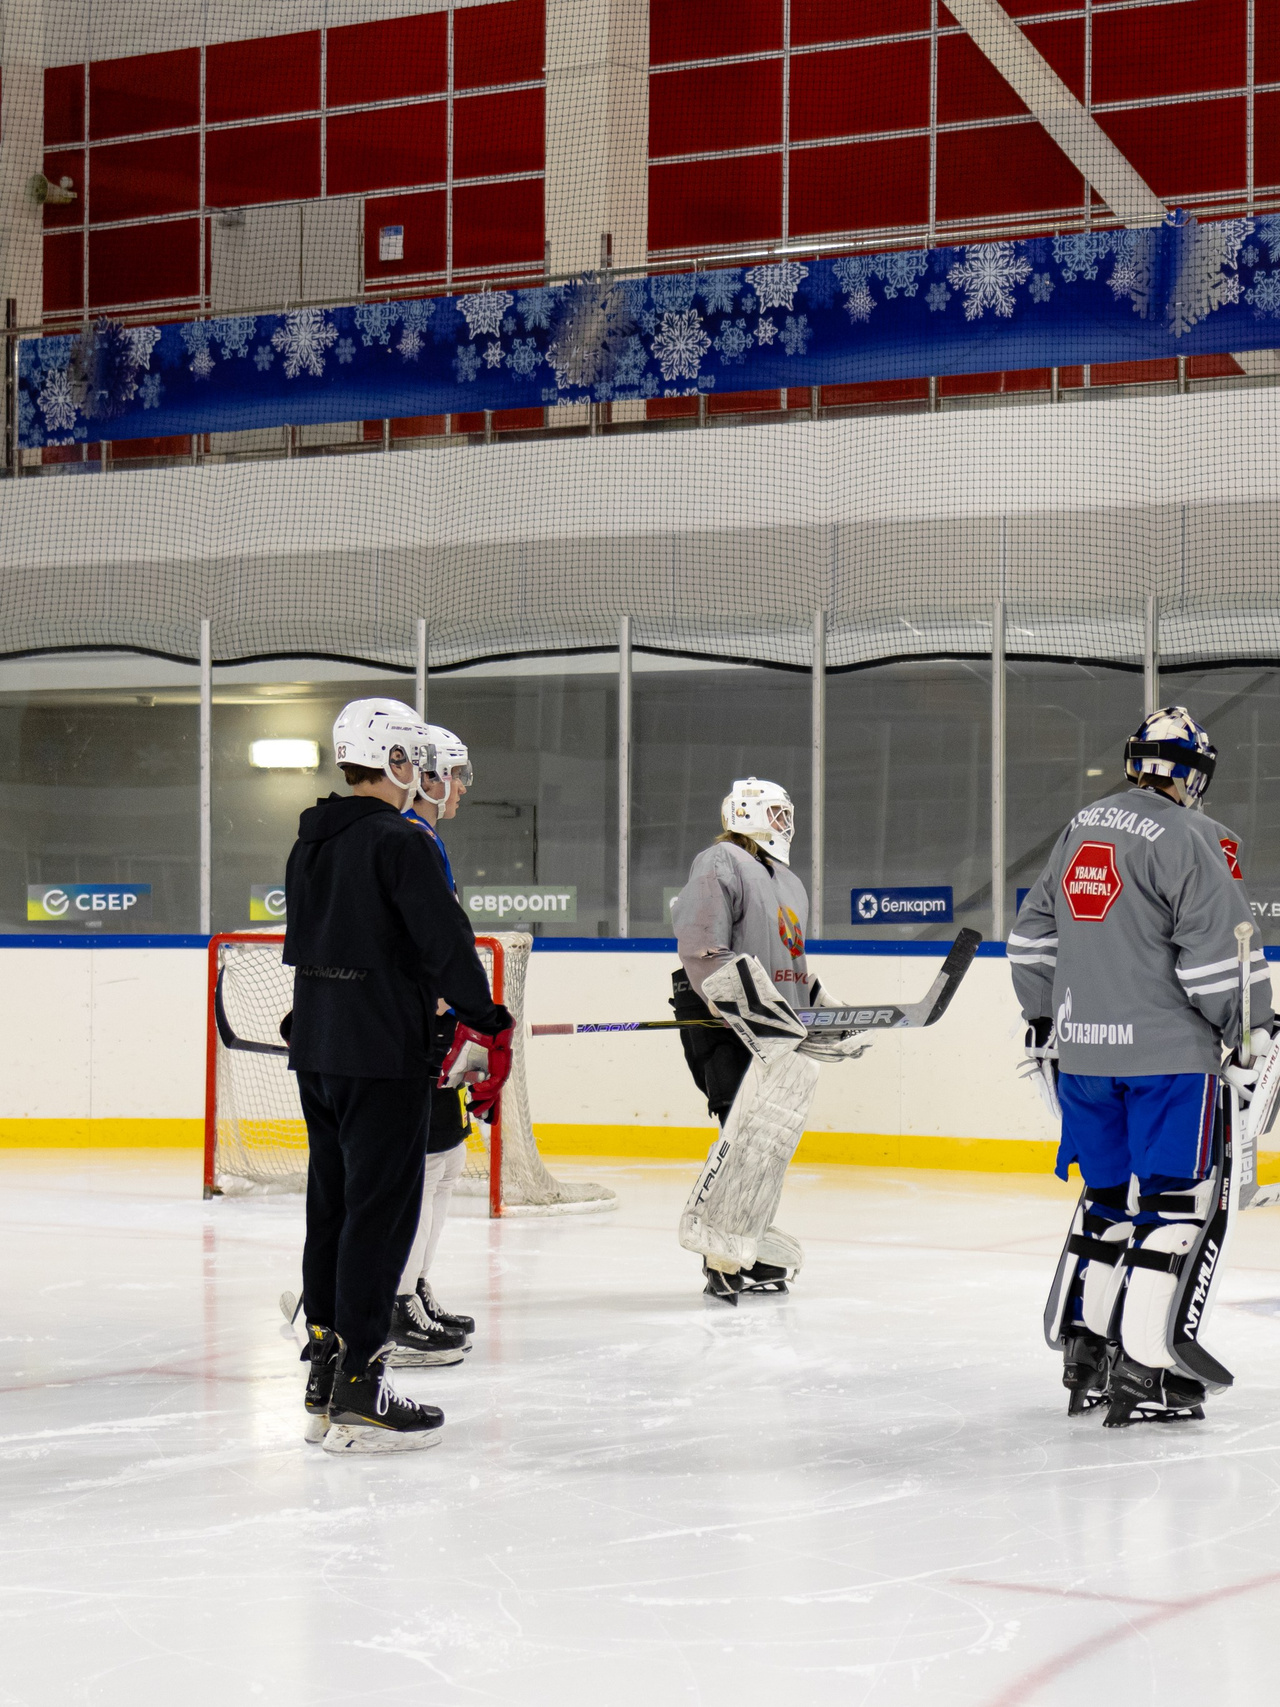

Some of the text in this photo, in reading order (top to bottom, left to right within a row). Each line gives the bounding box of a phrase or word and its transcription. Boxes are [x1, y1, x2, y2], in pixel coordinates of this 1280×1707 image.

[1075, 866, 1108, 881] УВАЖАЙ
[1069, 881, 1112, 896] ПАРТНЕРА!
[75, 893, 138, 911] СБЕР
[469, 894, 571, 917] евроопт
[881, 897, 946, 916] белкарт
[799, 1008, 894, 1027] BAUER
[1072, 1022, 1134, 1045] ГАЗПРОМ
[694, 1140, 731, 1207] TRUE
[1221, 1177, 1230, 1211] ULTRA
